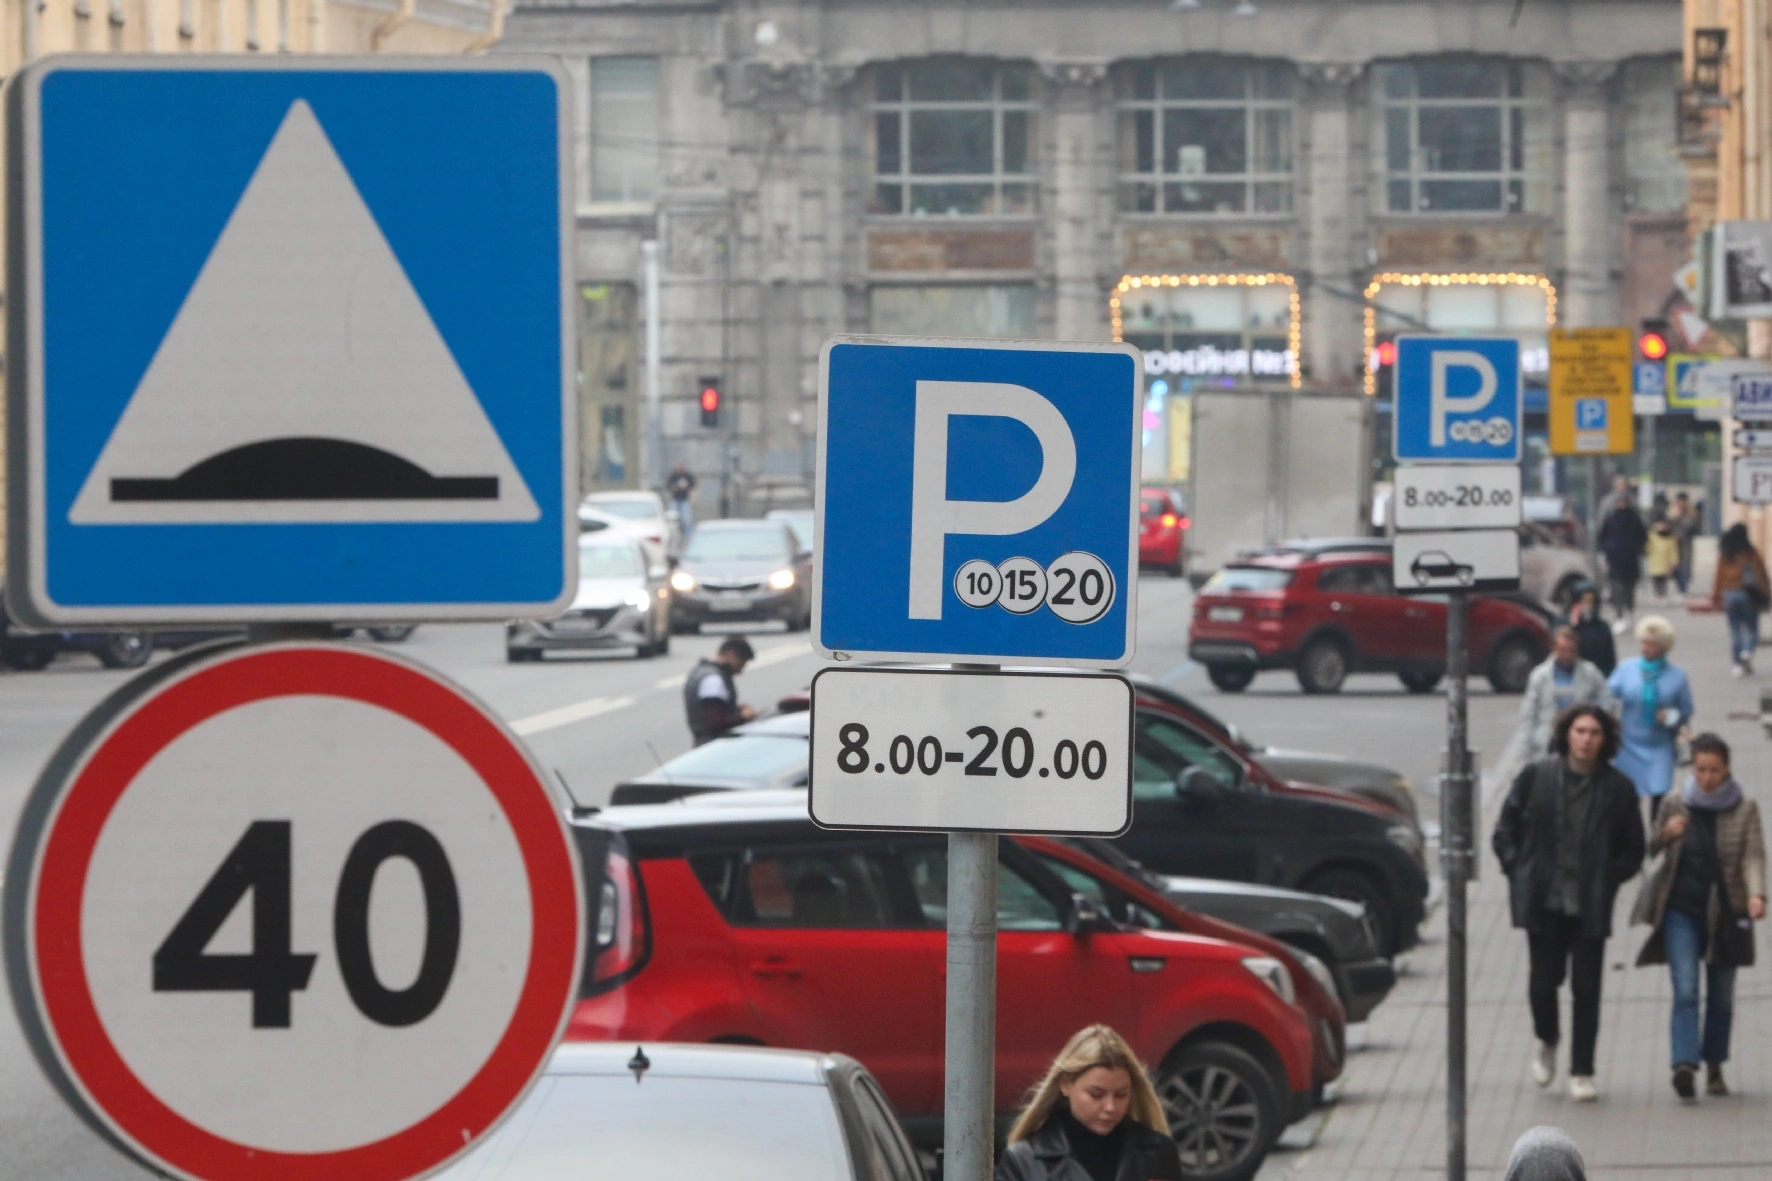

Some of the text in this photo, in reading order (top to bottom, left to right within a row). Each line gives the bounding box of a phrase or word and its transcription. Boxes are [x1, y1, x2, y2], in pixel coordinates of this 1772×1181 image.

[1143, 344, 1249, 375] ОФЕЙНЯ
[1430, 350, 1498, 448] P
[908, 379, 1077, 621] P
[1404, 486, 1513, 509] 8.00-20.00
[966, 567, 1105, 607] 10 15 20
[836, 722, 1108, 781] 8.00-20.00
[152, 819, 461, 1029] 40
